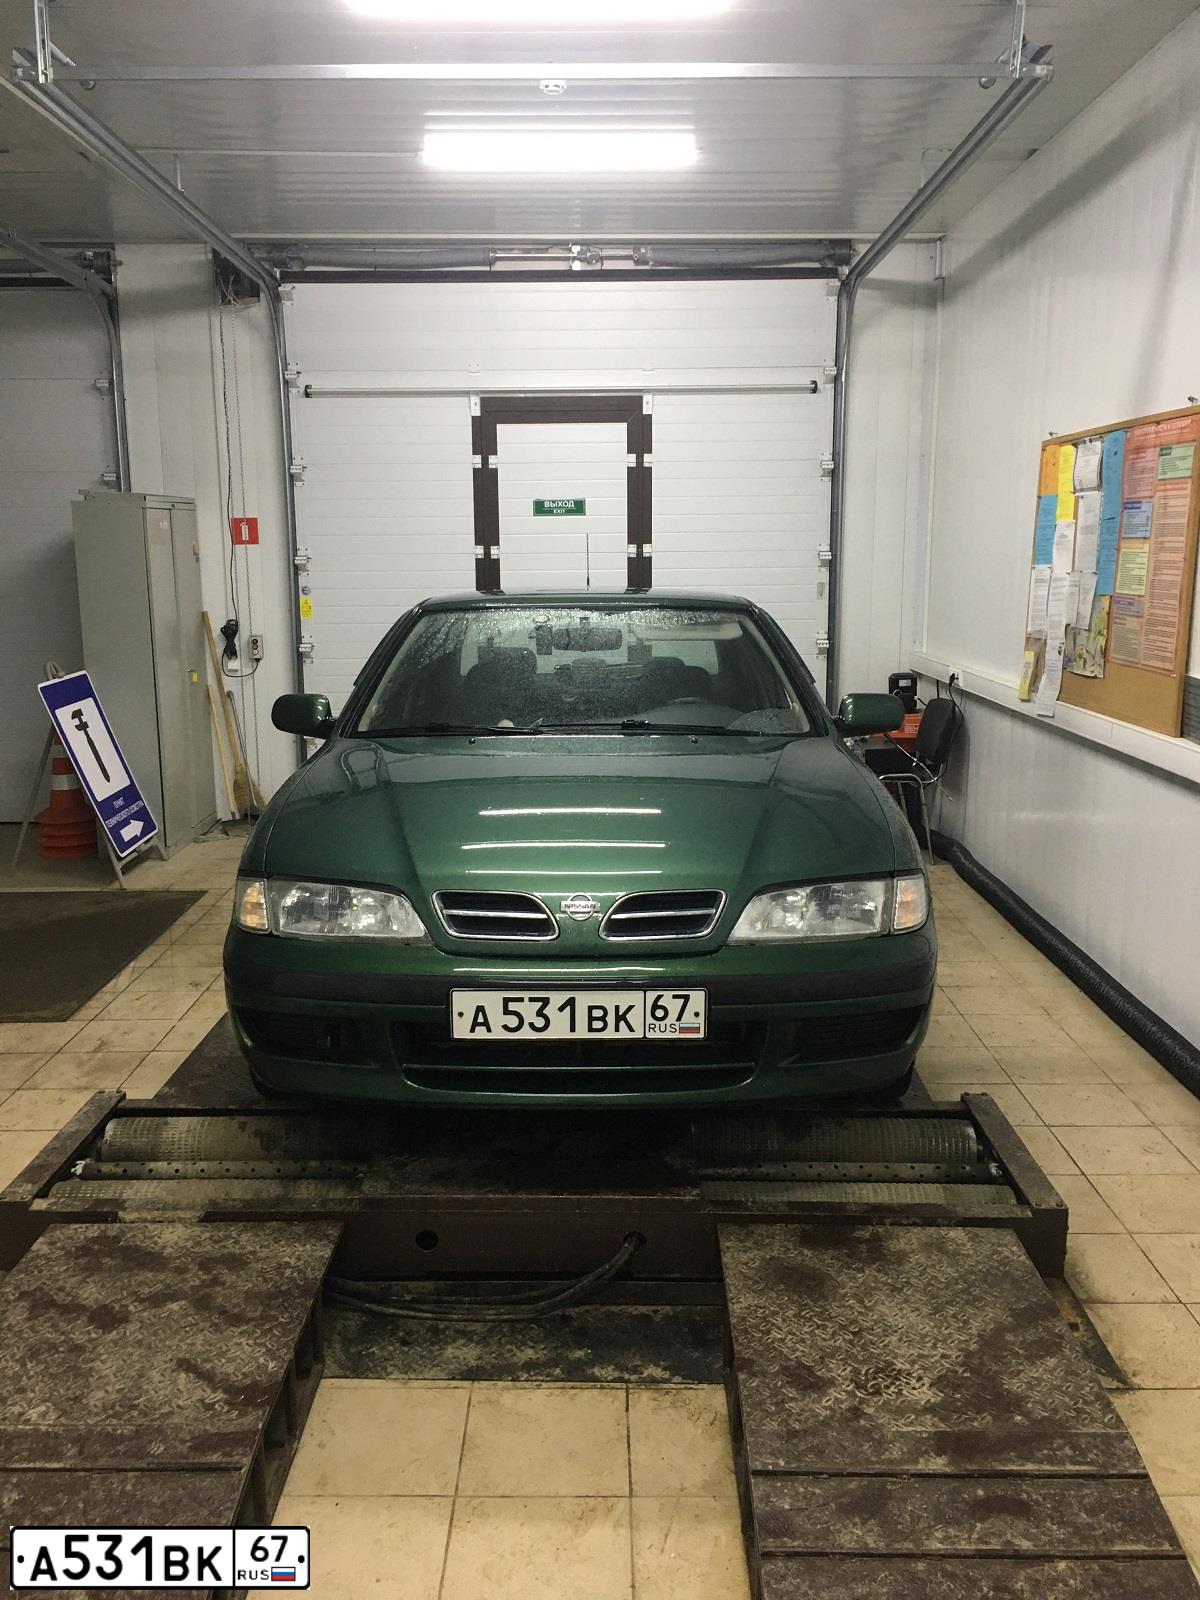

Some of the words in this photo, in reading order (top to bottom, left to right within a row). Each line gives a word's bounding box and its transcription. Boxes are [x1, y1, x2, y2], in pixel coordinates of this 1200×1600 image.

[544, 500, 575, 508] ВЫХОД
[650, 994, 691, 1022] 67
[648, 1023, 678, 1033] RUS
